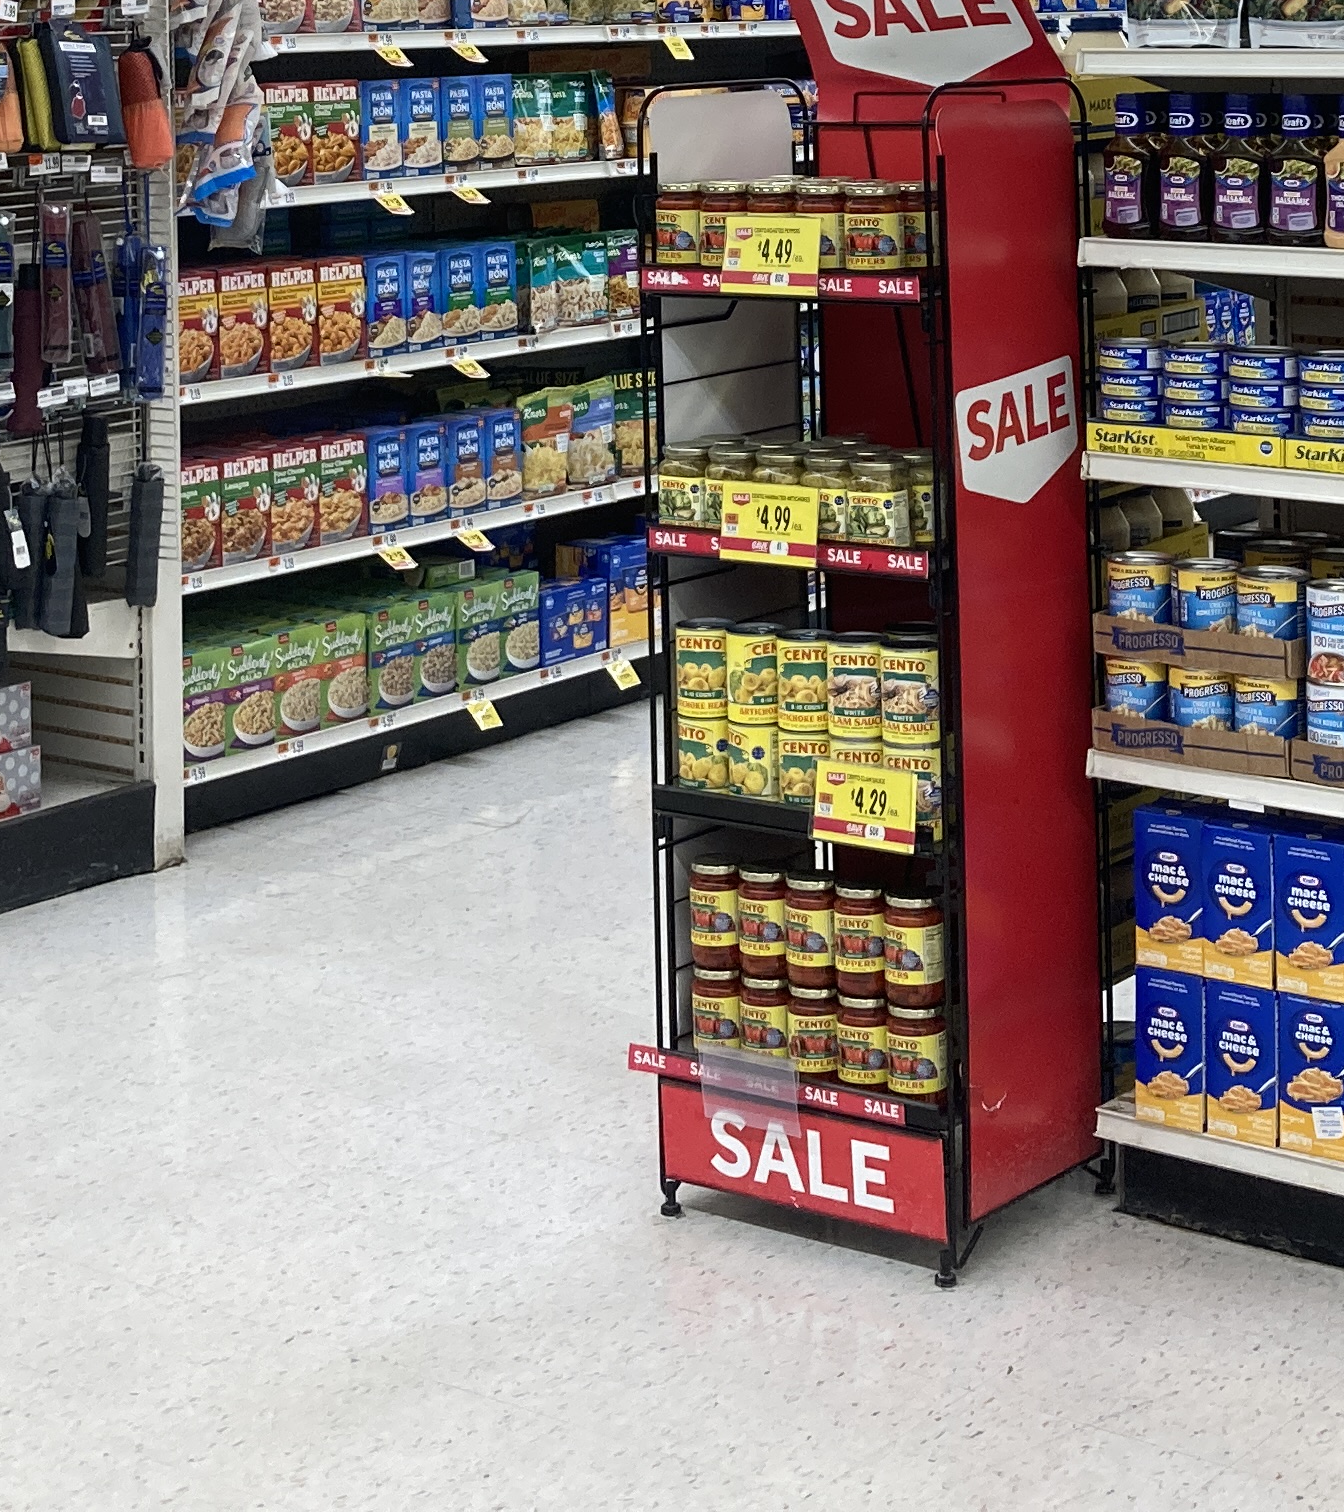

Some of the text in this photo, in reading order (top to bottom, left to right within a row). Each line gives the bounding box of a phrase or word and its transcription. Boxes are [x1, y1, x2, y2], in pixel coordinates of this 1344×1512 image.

[819, 278, 852, 292] SALE
[878, 280, 913, 294] SALE
[966, 371, 1070, 461] SALE
[1094, 428, 1154, 445] StarKist
[655, 532, 687, 547] SALE
[828, 549, 861, 564] SALE
[888, 554, 923, 570] SALE
[680, 638, 722, 649] CENTO
[1118, 634, 1179, 649] PROGRESSO
[833, 655, 876, 666] CENTO
[884, 660, 926, 672] CENTO
[783, 742, 828, 754] CENTO
[634, 1051, 666, 1068] SALE
[805, 1088, 838, 1106] SALE
[864, 1099, 899, 1118] SALE
[710, 1111, 895, 1213] SALE
